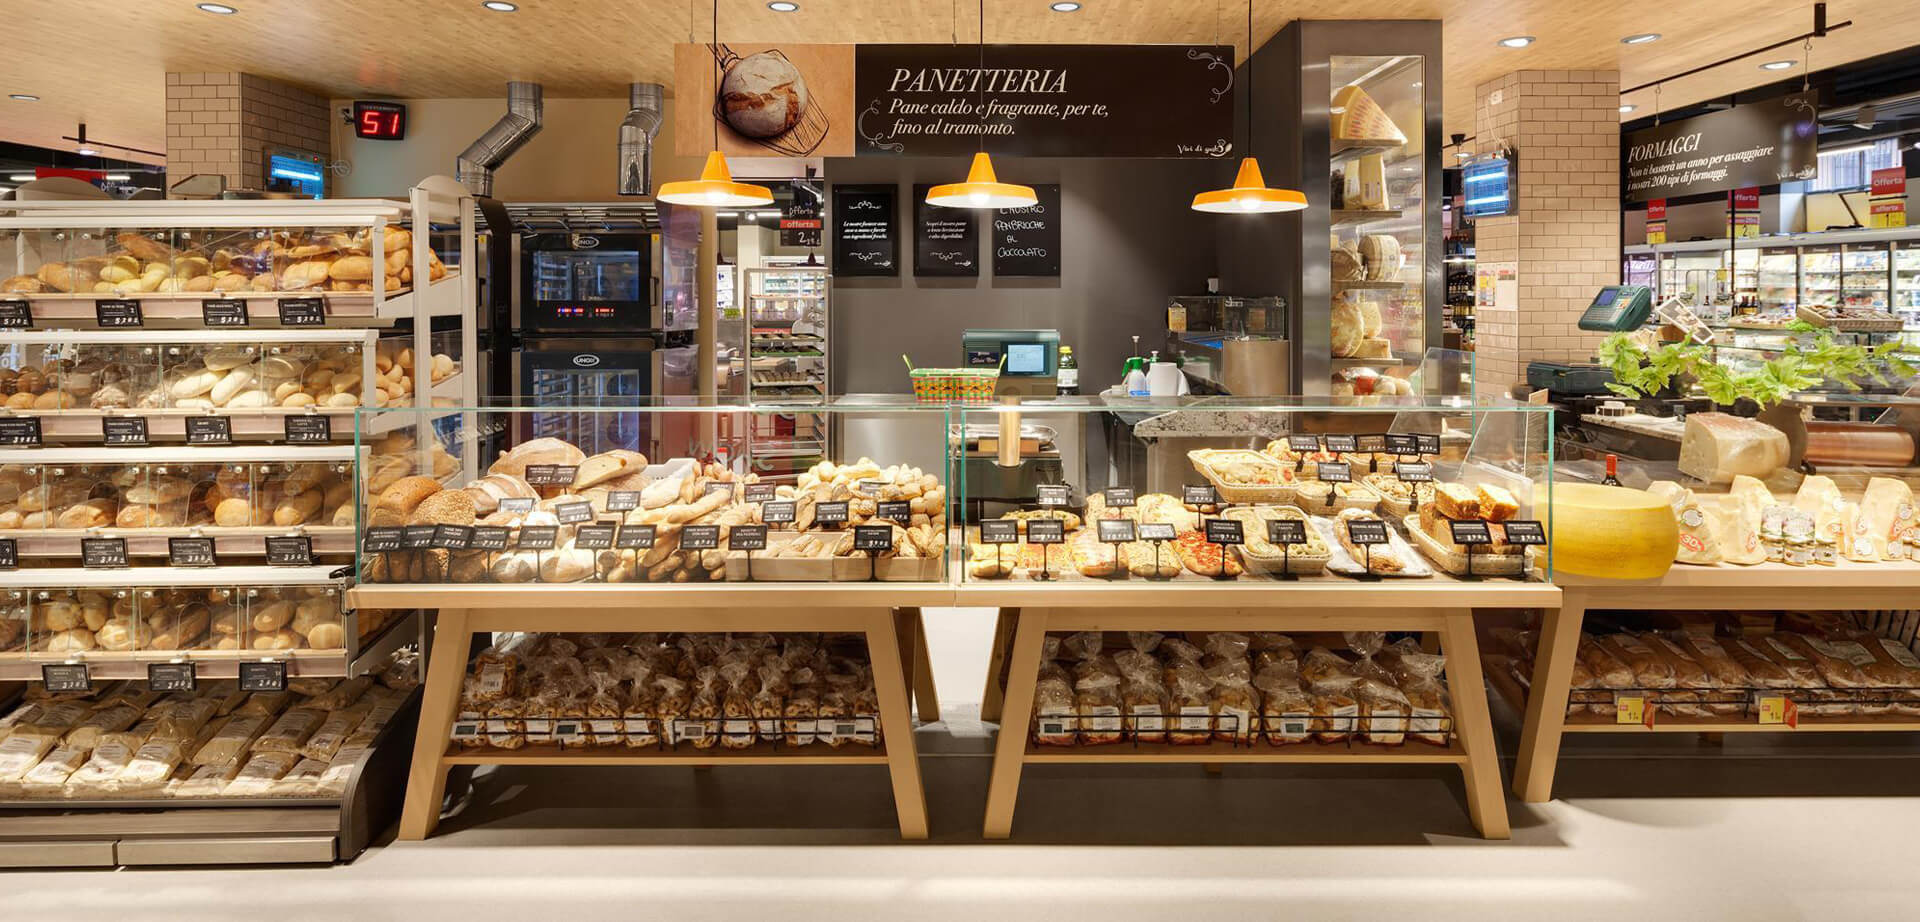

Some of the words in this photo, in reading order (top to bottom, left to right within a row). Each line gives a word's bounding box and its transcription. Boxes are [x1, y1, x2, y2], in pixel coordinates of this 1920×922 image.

[888, 69, 1067, 93] PANETTERIA
[888, 99, 928, 115] Pane
[931, 99, 972, 115] caldo
[981, 99, 1060, 119] fragrante,
[1062, 103, 1090, 119] per
[1092, 103, 1109, 118] te,
[362, 111, 399, 135] 51
[887, 119, 922, 138] fino
[925, 119, 942, 135] al
[943, 120, 1016, 136] tramonto.
[1628, 132, 1703, 163] FORMAGGI
[1628, 166, 1643, 178] Non
[1643, 166, 1649, 177] ti
[1649, 159, 1676, 175] basterà
[1676, 161, 1687, 171] un
[1687, 157, 1708, 169] anno
[1708, 154, 1724, 168] per
[1724, 145, 1775, 164] assaggiare
[1631, 178, 1651, 190] nostri
[1651, 176, 1667, 187] 200
[1667, 172, 1681, 188] tipi
[1681, 170, 1689, 183] di
[1688, 165, 1729, 185] formaggi.
[1874, 176, 1903, 187] Offerta
[786, 220, 814, 228] offerta
